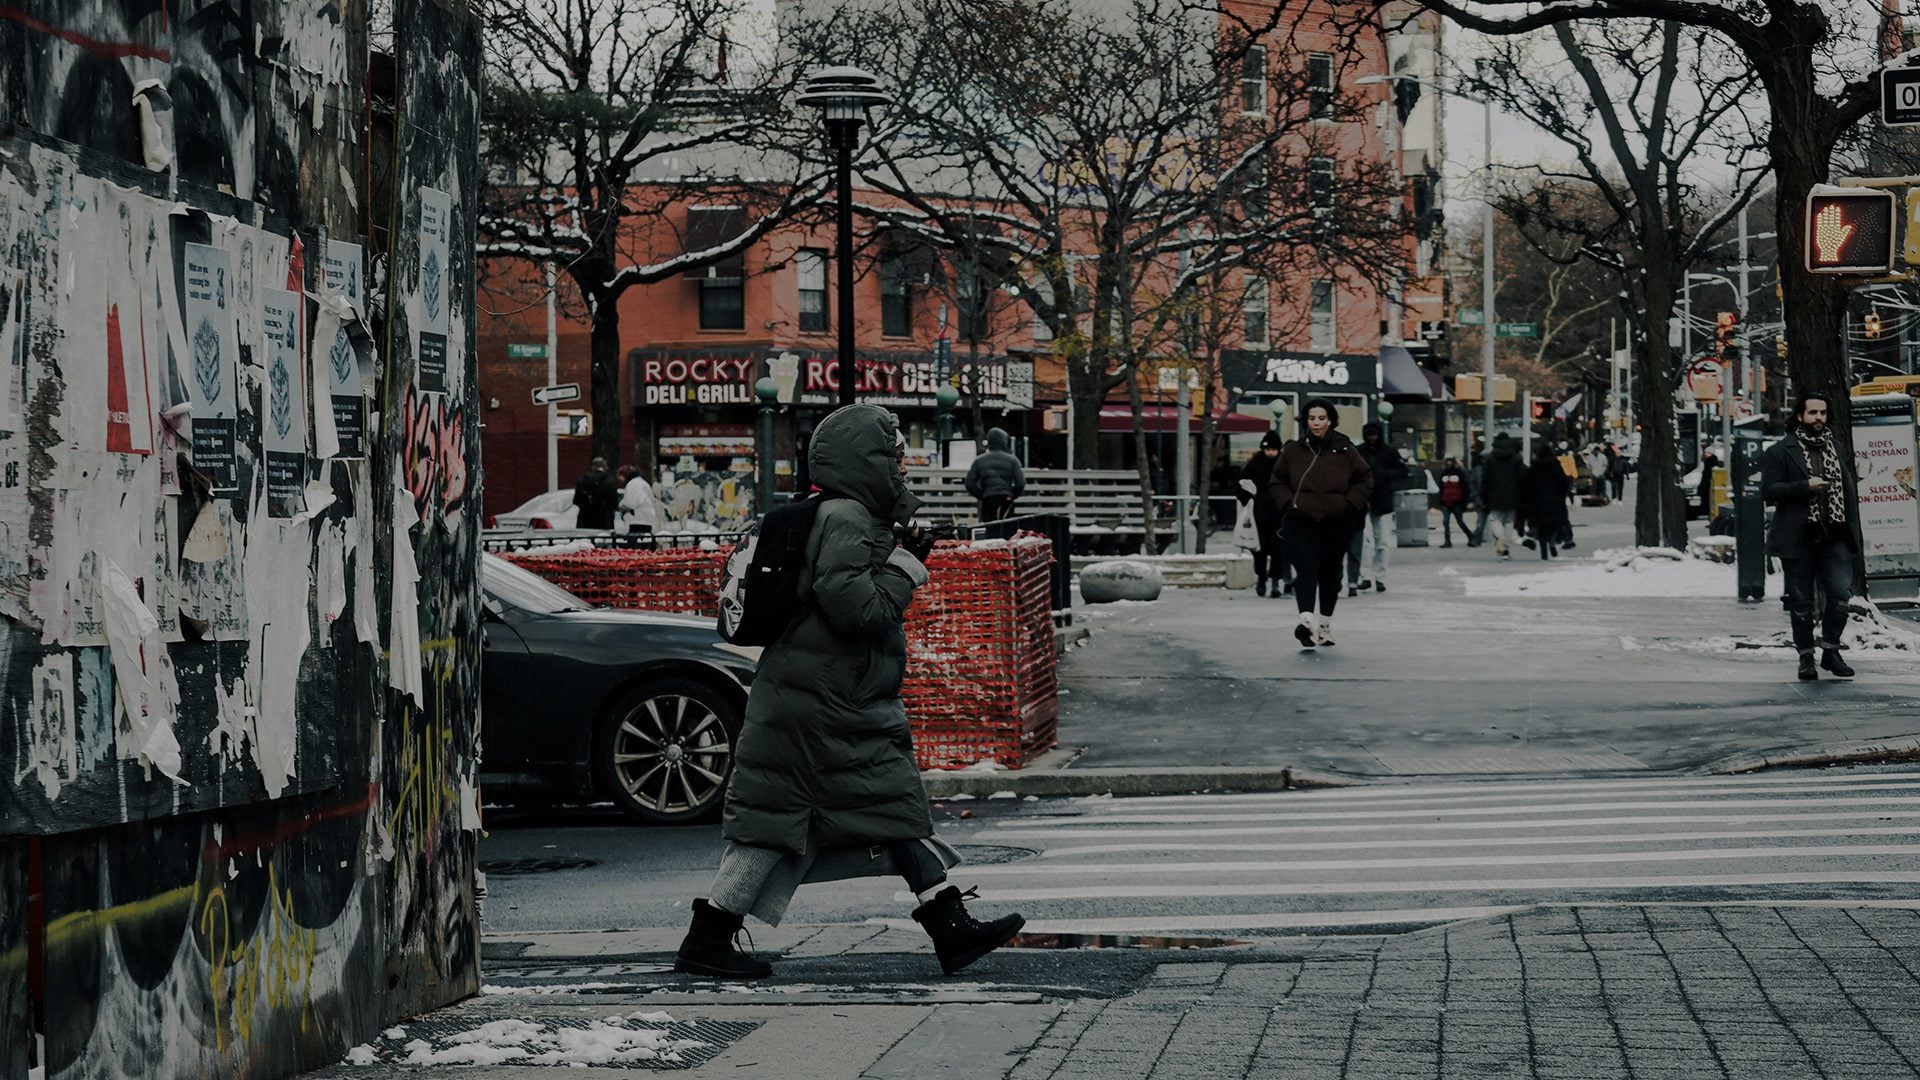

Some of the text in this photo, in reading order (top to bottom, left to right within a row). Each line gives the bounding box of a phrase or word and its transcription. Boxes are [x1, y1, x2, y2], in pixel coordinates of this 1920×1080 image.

[1902, 86, 1920, 107] O
[643, 358, 752, 383] ROCKY
[646, 384, 751, 404] DELI GRILL
[1747, 441, 1758, 457] P
[1868, 440, 1894, 448] RIDES
[1855, 447, 1909, 458] ON-DEMAND
[1869, 485, 1898, 494] SLICES
